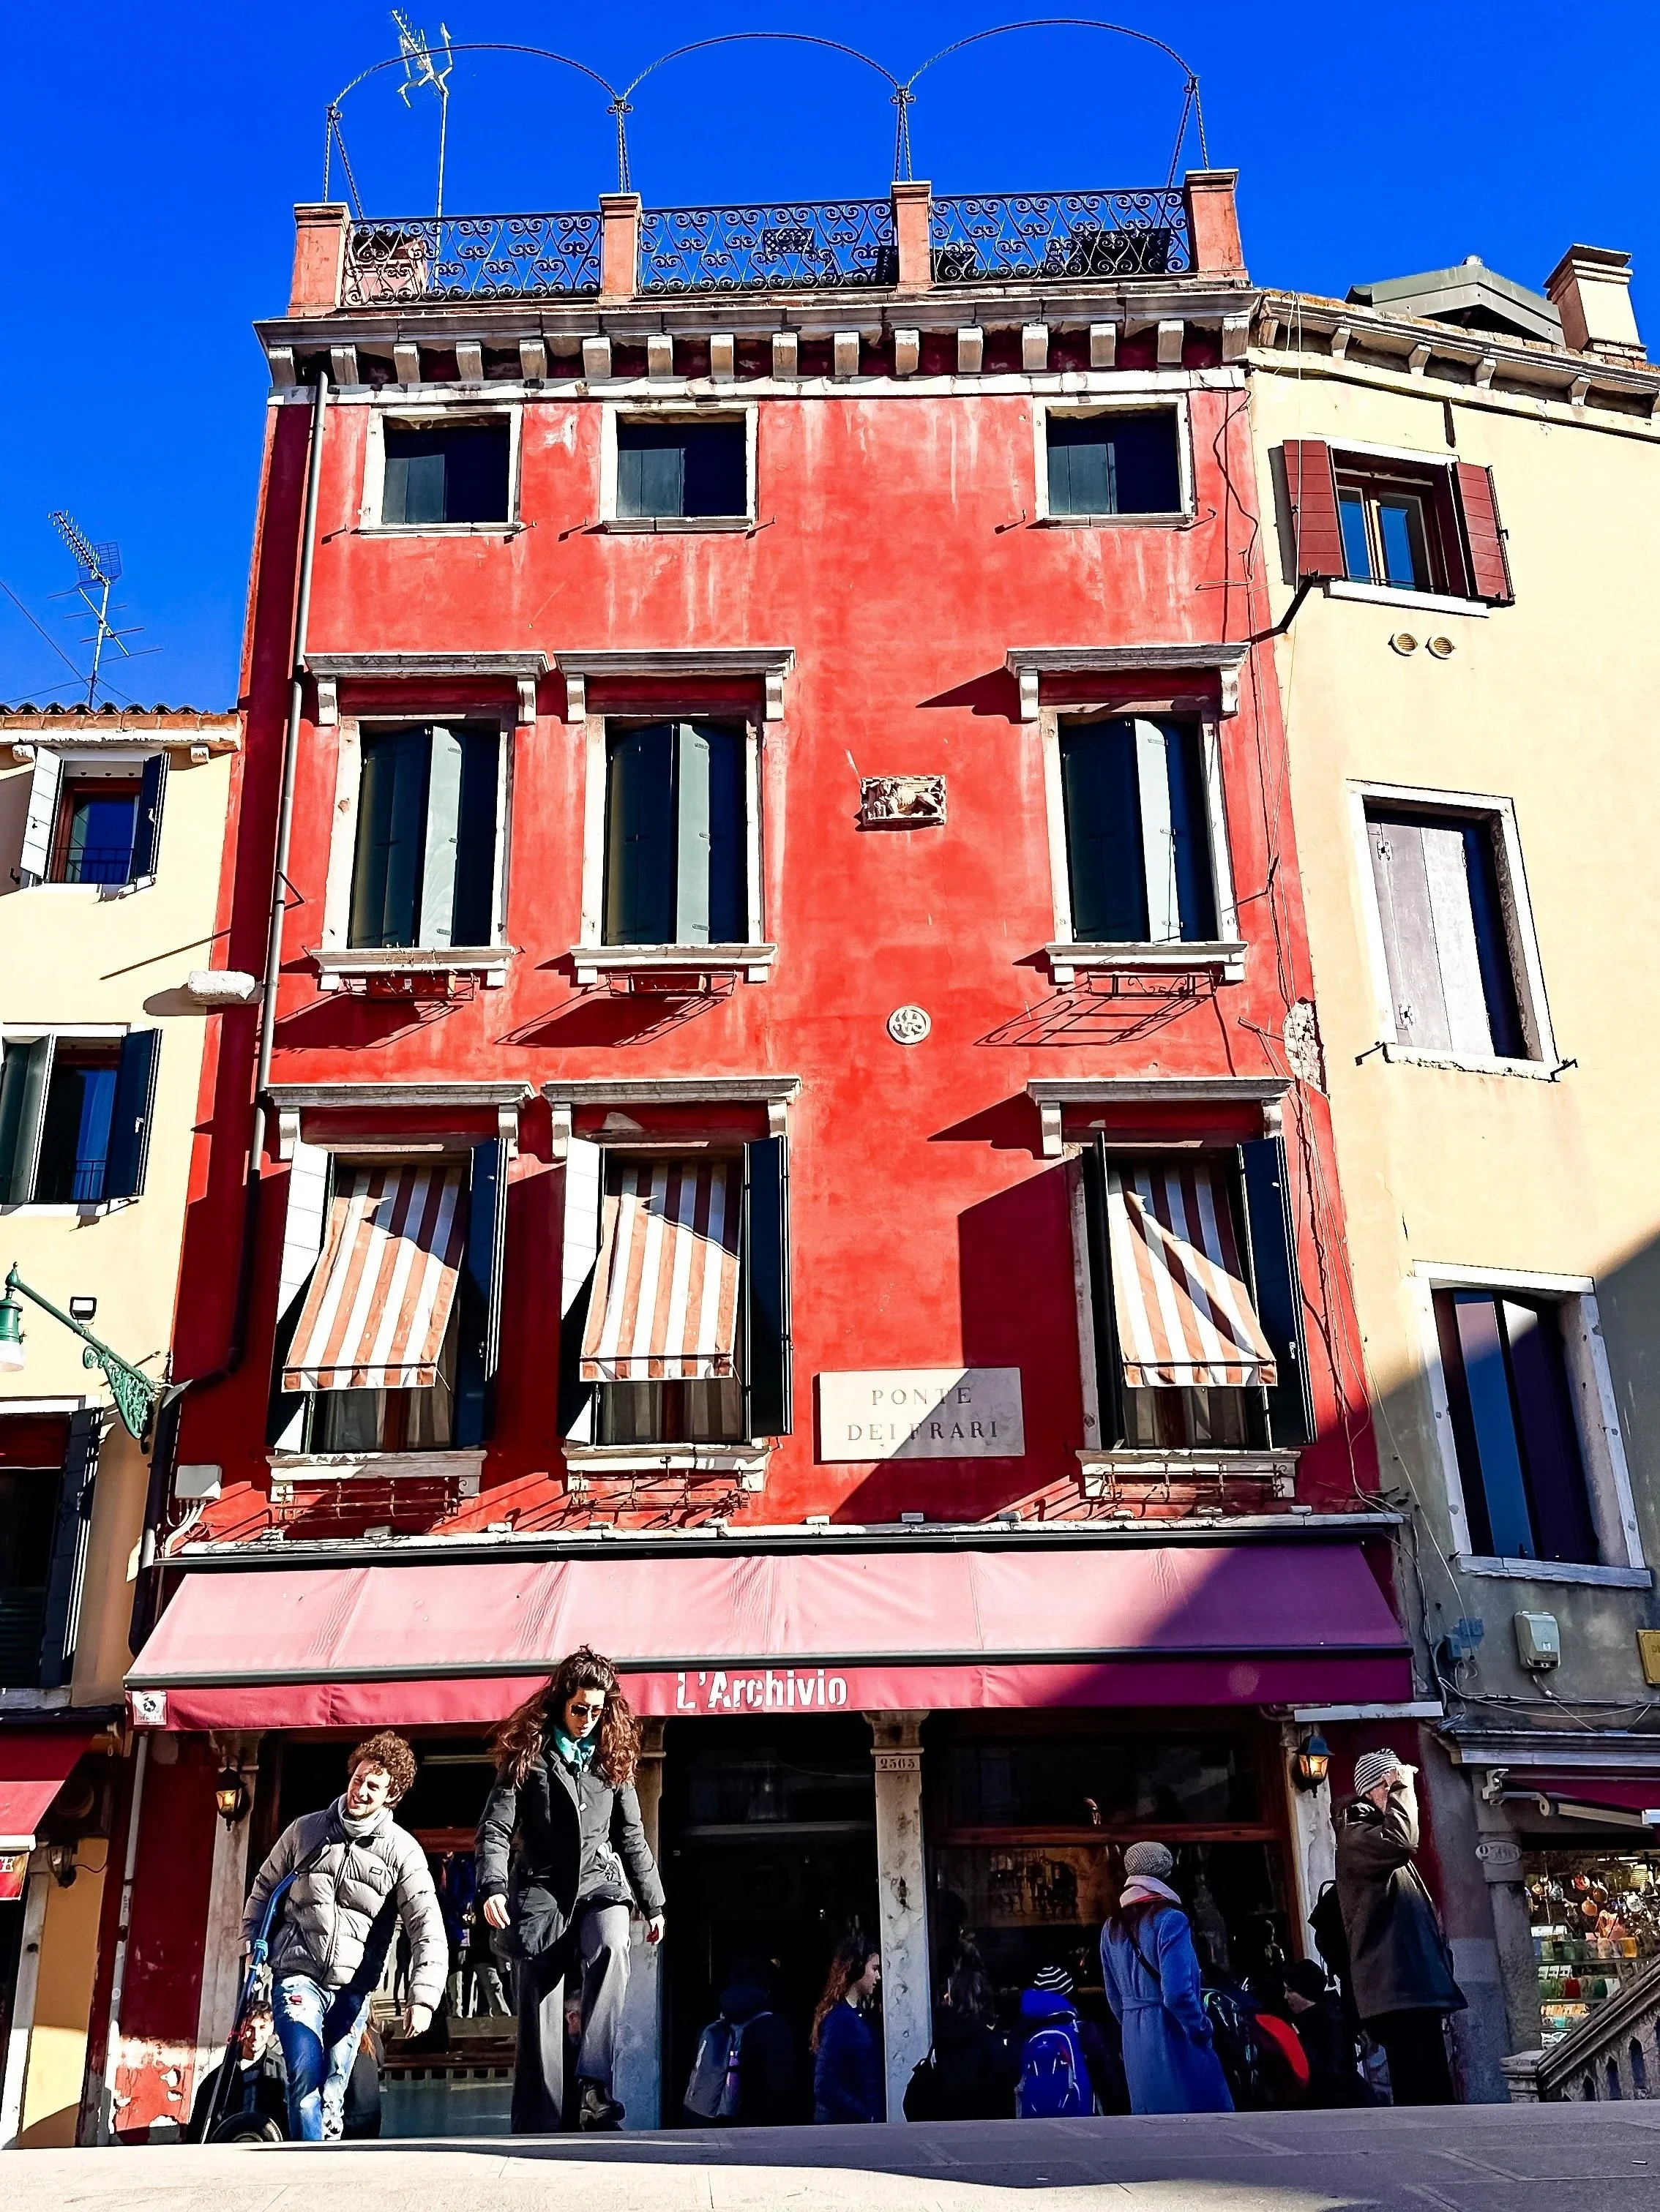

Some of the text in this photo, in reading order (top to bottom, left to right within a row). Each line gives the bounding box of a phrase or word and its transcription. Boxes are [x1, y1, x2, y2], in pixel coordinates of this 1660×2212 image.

[872, 1388, 971, 1406] PONTE
[848, 1422, 997, 1441] DEI FRARI
[677, 1669, 848, 1709] L'Archivio
[880, 1758, 915, 1769] 2565
